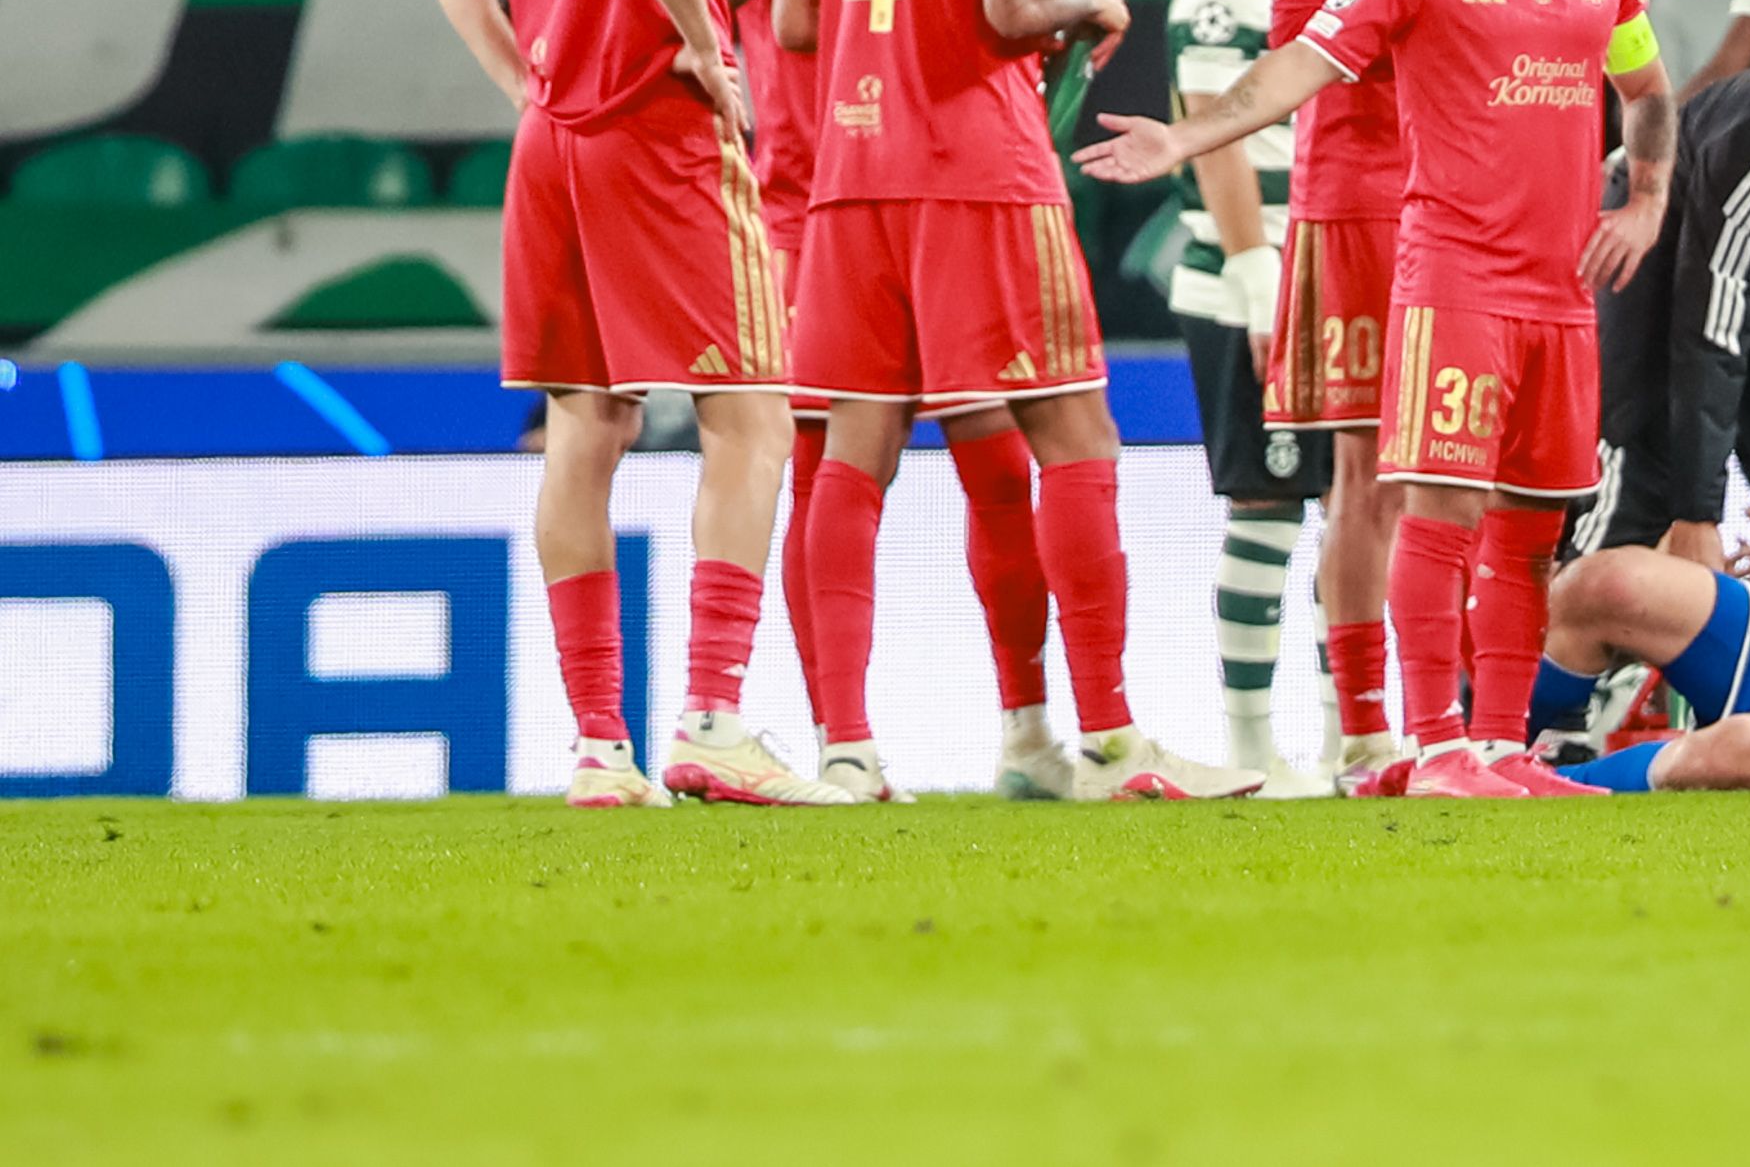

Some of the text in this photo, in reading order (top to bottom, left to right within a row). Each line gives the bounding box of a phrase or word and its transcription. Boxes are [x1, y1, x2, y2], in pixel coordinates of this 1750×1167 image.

[1486, 75, 1597, 111] Kornspitz
[1512, 53, 1589, 84] Original
[1323, 315, 1381, 381] 20
[1431, 366, 1502, 438] 30
